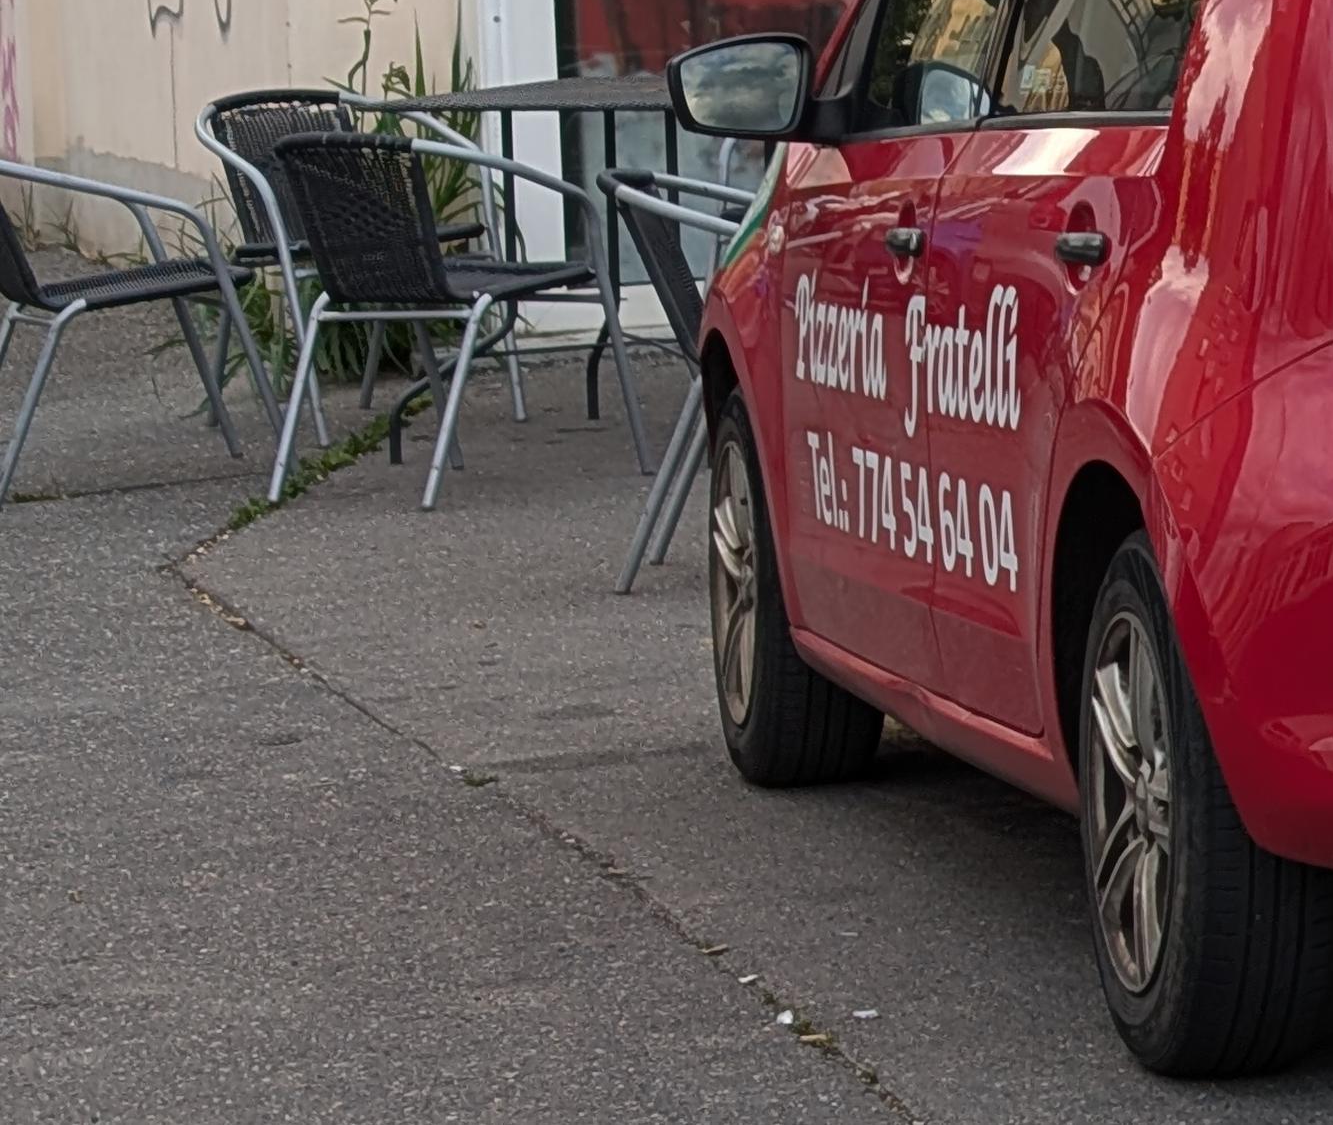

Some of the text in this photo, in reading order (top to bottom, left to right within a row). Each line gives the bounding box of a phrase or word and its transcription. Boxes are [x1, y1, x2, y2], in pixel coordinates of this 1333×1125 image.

[794, 268, 1021, 438] Pizzeria Fratelli
[806, 431, 1019, 593] Tel.: 774 54 64 04
